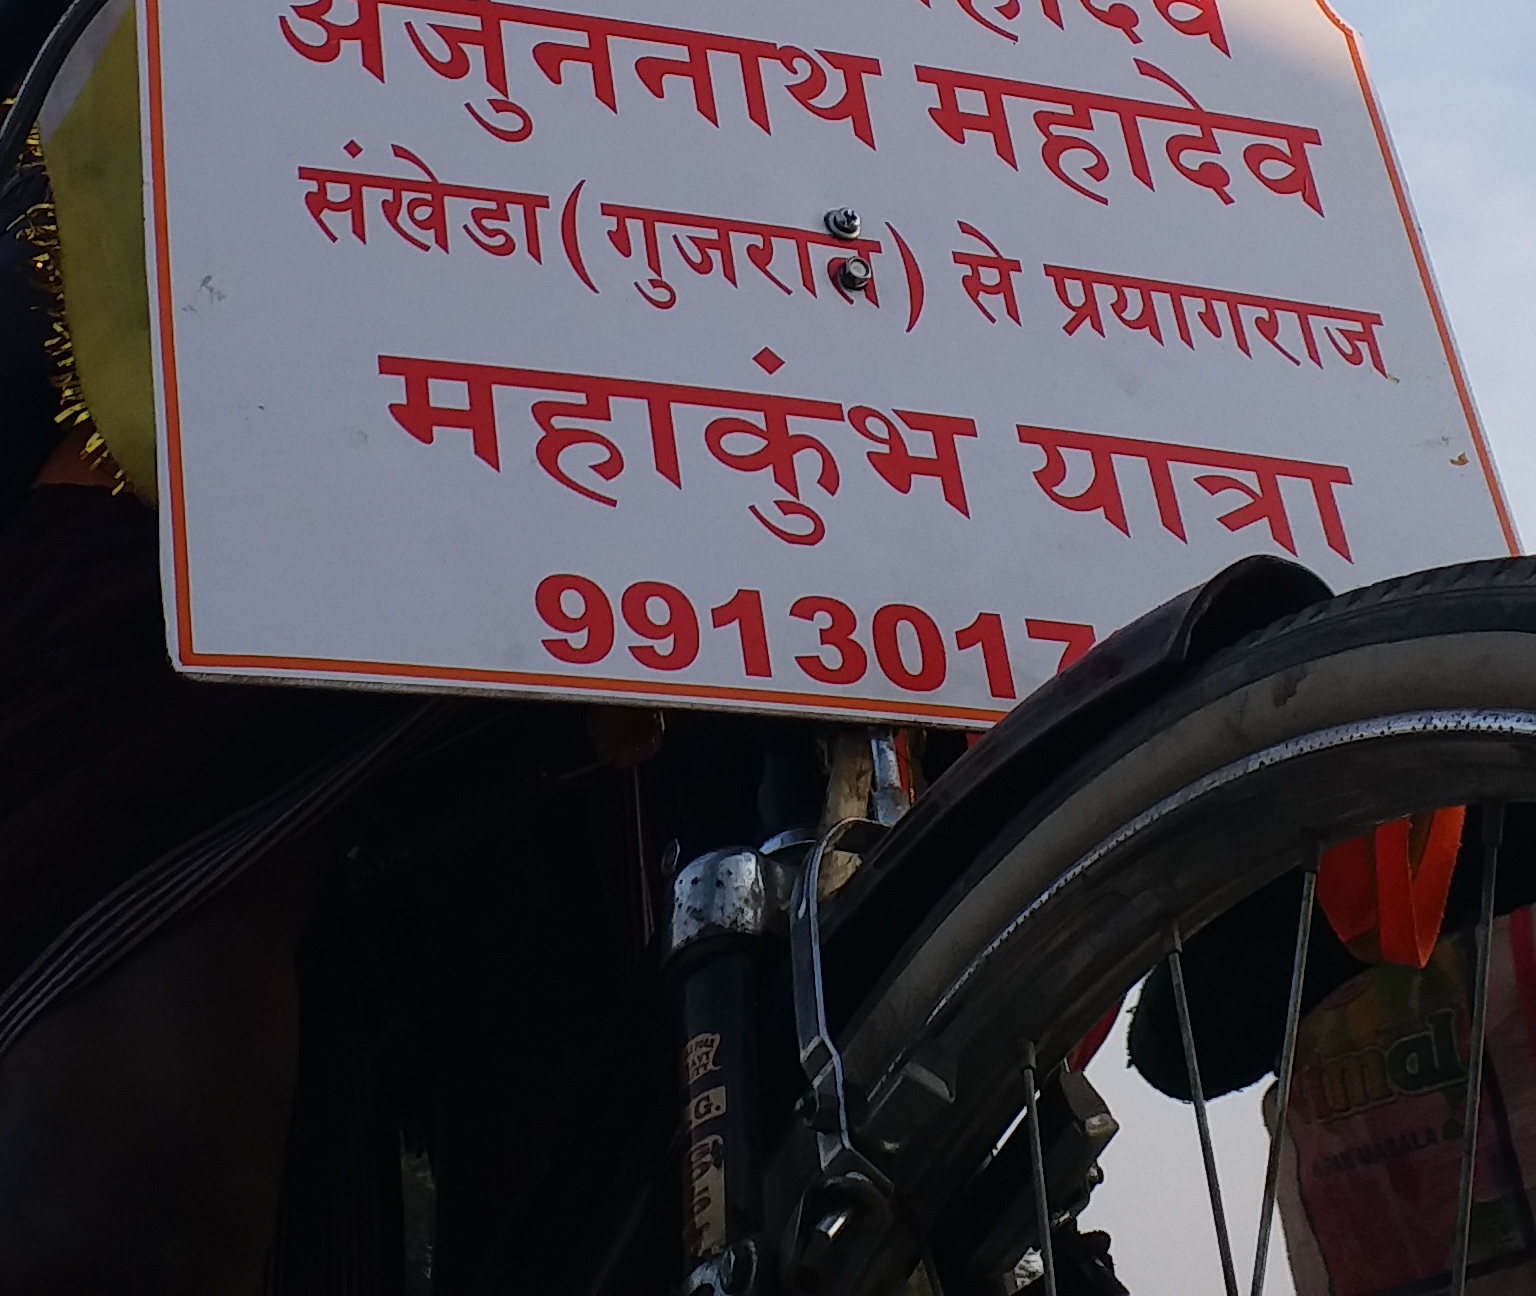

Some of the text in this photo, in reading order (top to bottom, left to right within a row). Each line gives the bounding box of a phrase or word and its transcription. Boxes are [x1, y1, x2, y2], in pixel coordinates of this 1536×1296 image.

[915, 59, 1323, 217] महादेव
[953, 222, 1022, 323] से
[1043, 264, 1386, 375] प्रयागराज
[378, 348, 1352, 562] महाकुंभ यात्रा
